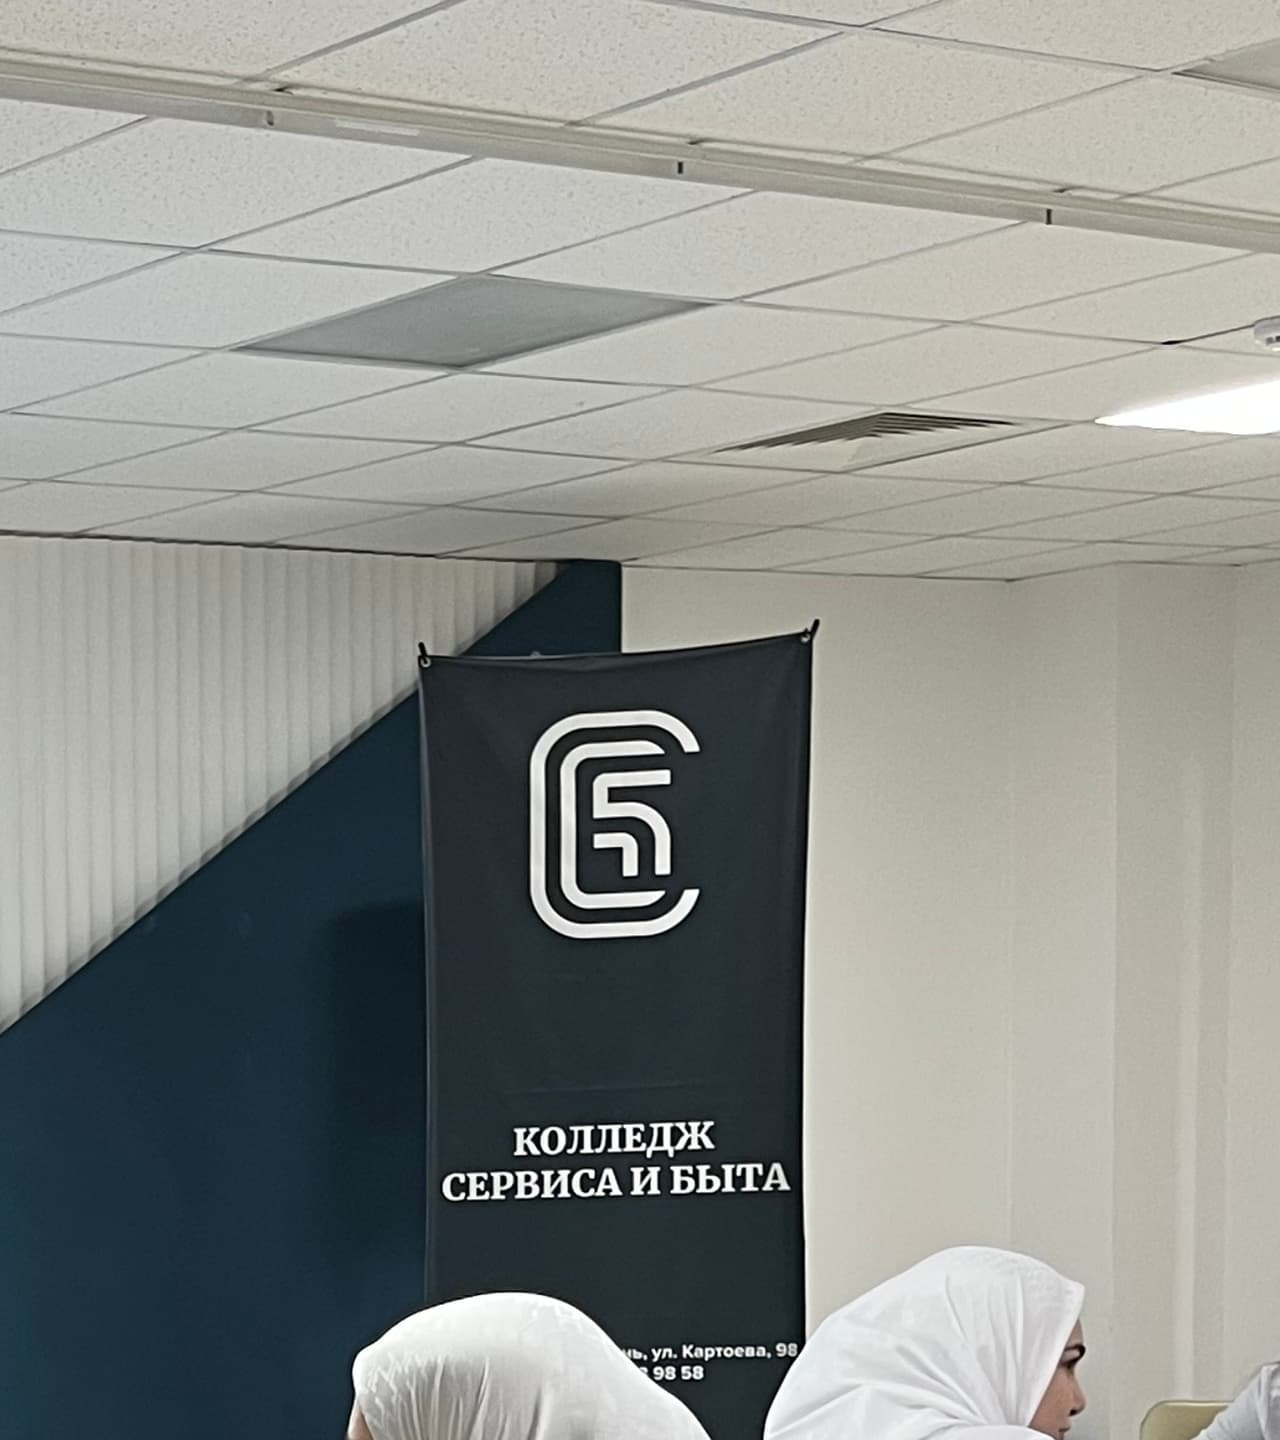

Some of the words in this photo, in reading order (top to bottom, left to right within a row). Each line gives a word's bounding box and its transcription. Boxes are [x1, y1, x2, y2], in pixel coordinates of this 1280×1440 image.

[513, 1121, 715, 1159] КОЛЛЕДЖ
[442, 1167, 622, 1201] СЕРВИСА
[630, 1165, 662, 1196] И
[669, 1162, 791, 1195] БЫТА
[651, 1347, 678, 1363] ул.
[682, 1343, 772, 1362] Картоева,
[775, 1342, 798, 1357] 98
[653, 1365, 676, 1380] 98
[681, 1365, 704, 1380] 58
